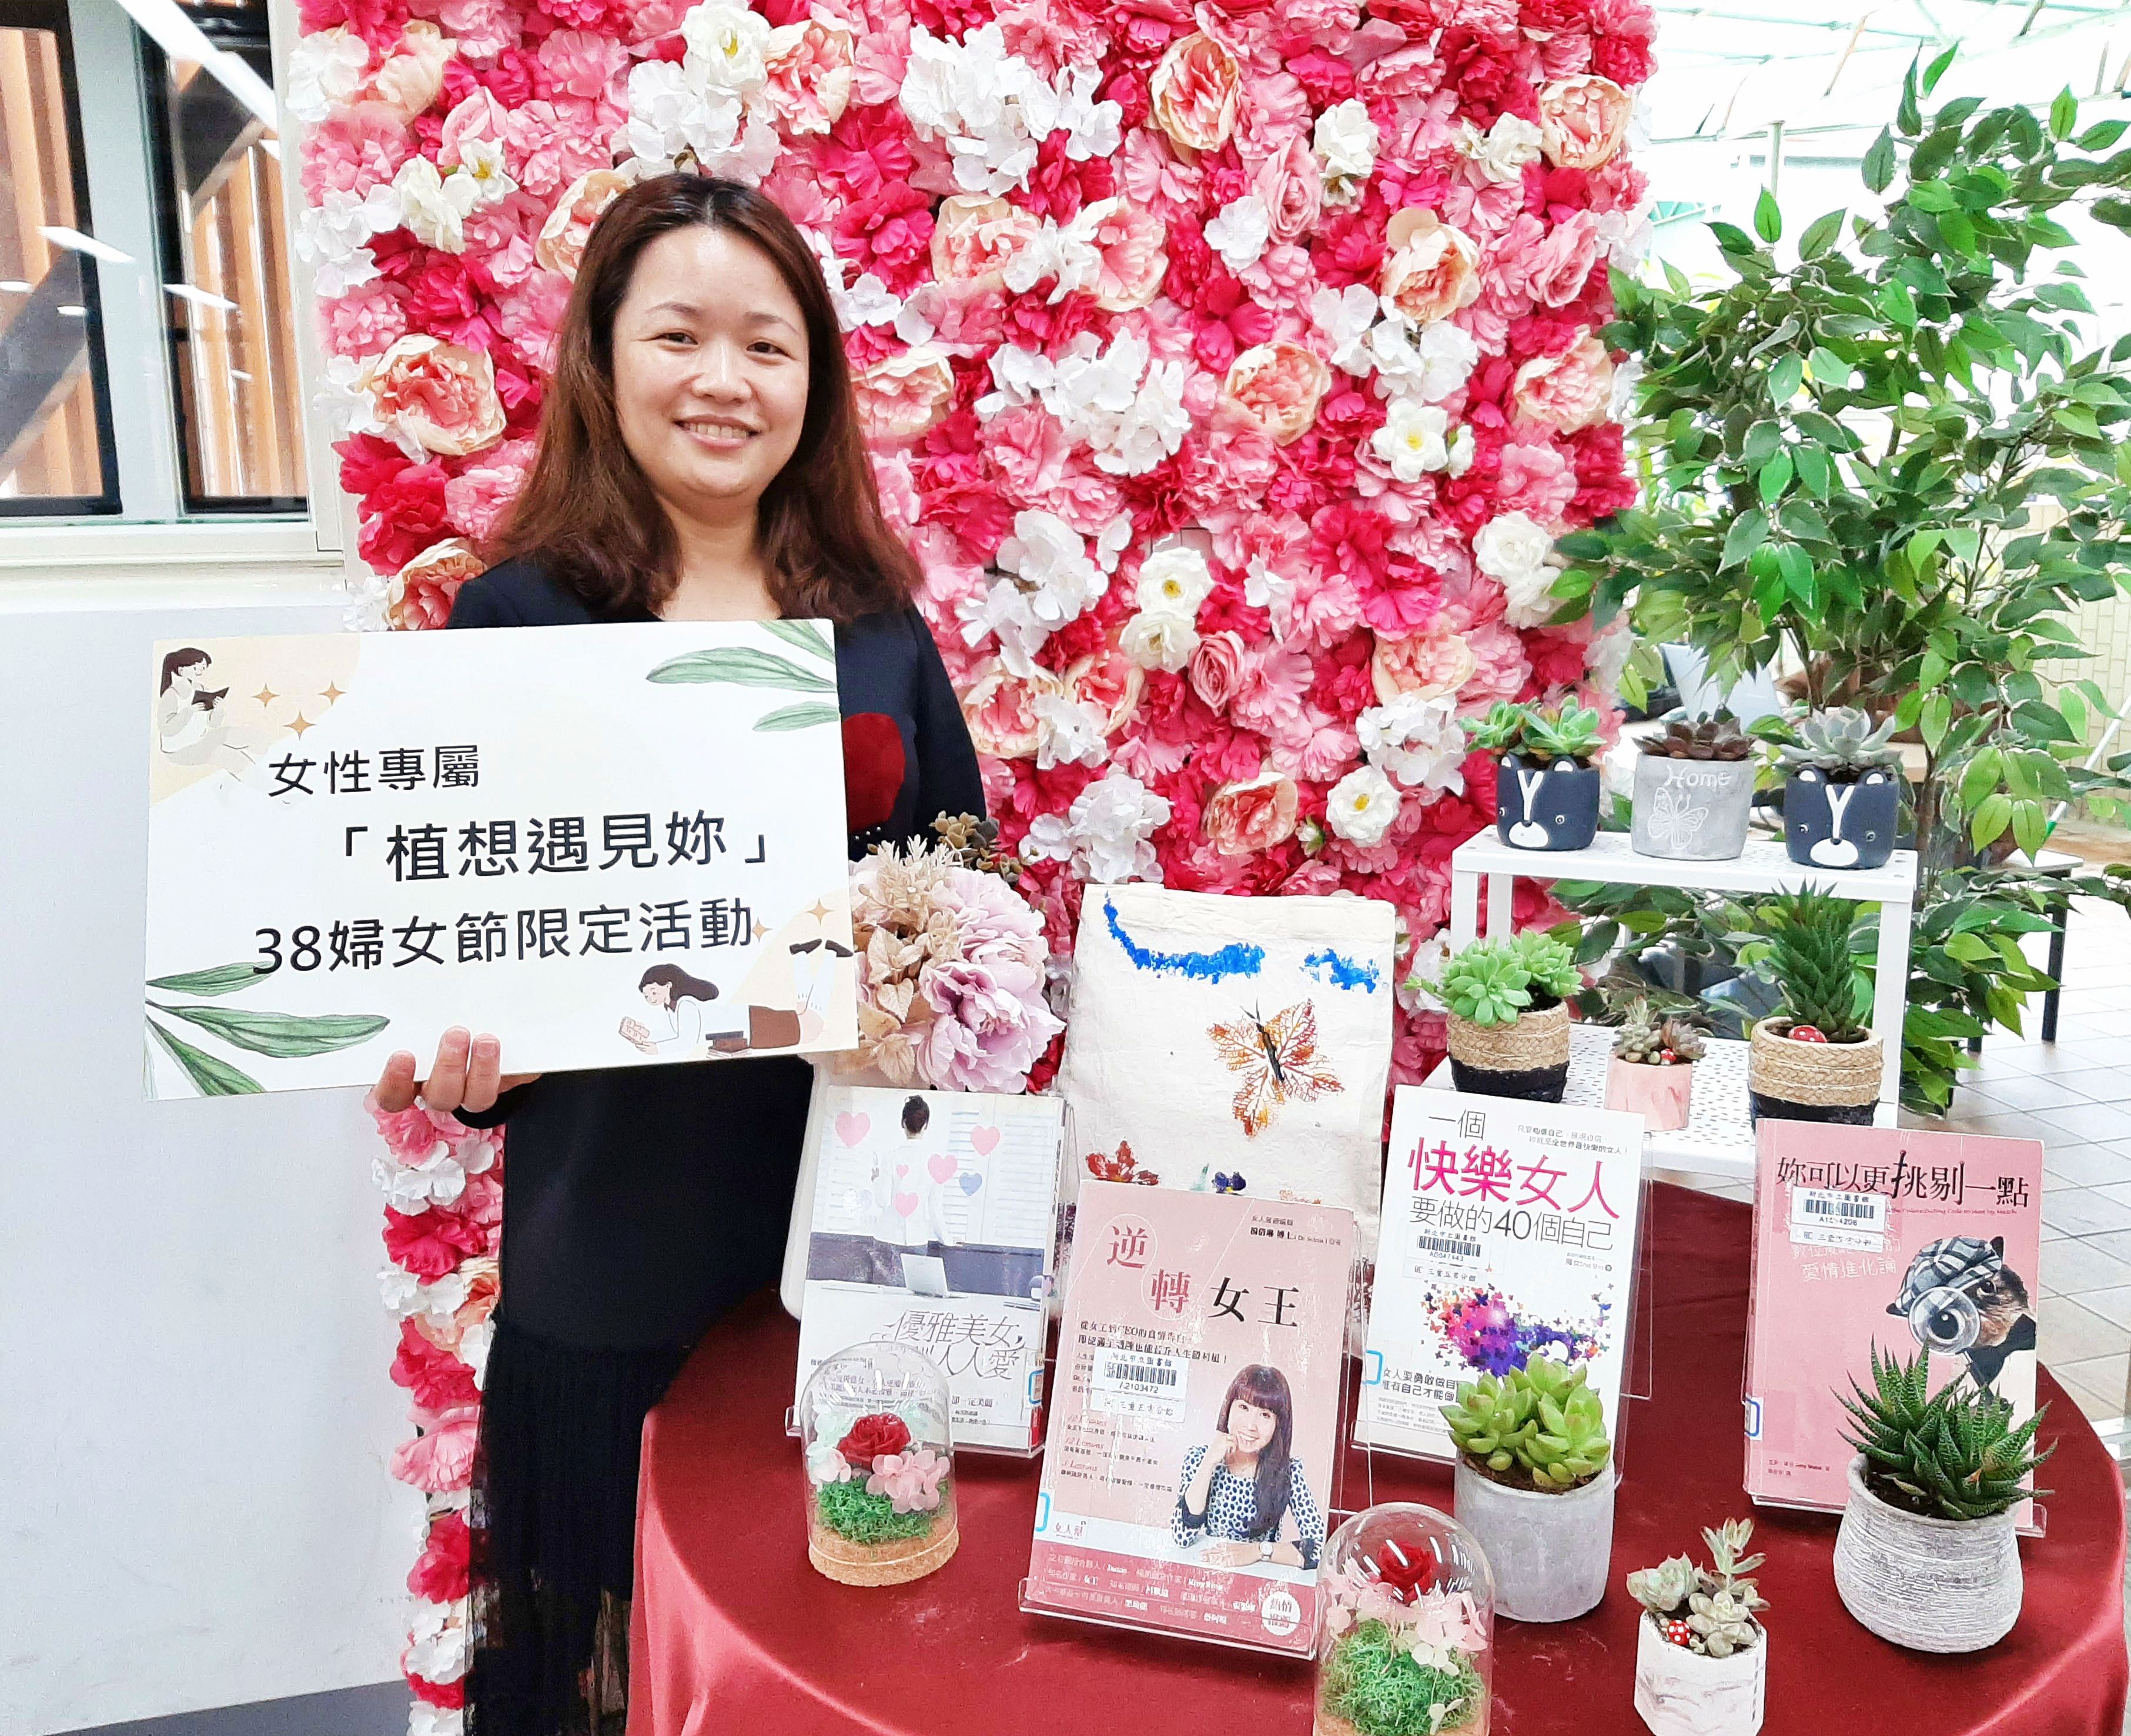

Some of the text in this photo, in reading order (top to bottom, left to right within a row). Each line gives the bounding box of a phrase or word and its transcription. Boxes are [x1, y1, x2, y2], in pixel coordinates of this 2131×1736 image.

[268, 744, 480, 798] 女性專屬
[1664, 765, 1732, 791] Home
[344, 809, 767, 882] 「植想遇見妳」
[253, 897, 752, 975] 38婦女節限定活動
[1429, 1109, 1486, 1140] 一個
[1407, 1137, 1620, 1219] 快樂女人
[1777, 1149, 2029, 1207] 妳可以更挑剔一點
[1410, 1196, 1614, 1252] 要做的40個自己
[922, 1344, 1019, 1380] 人人愛
